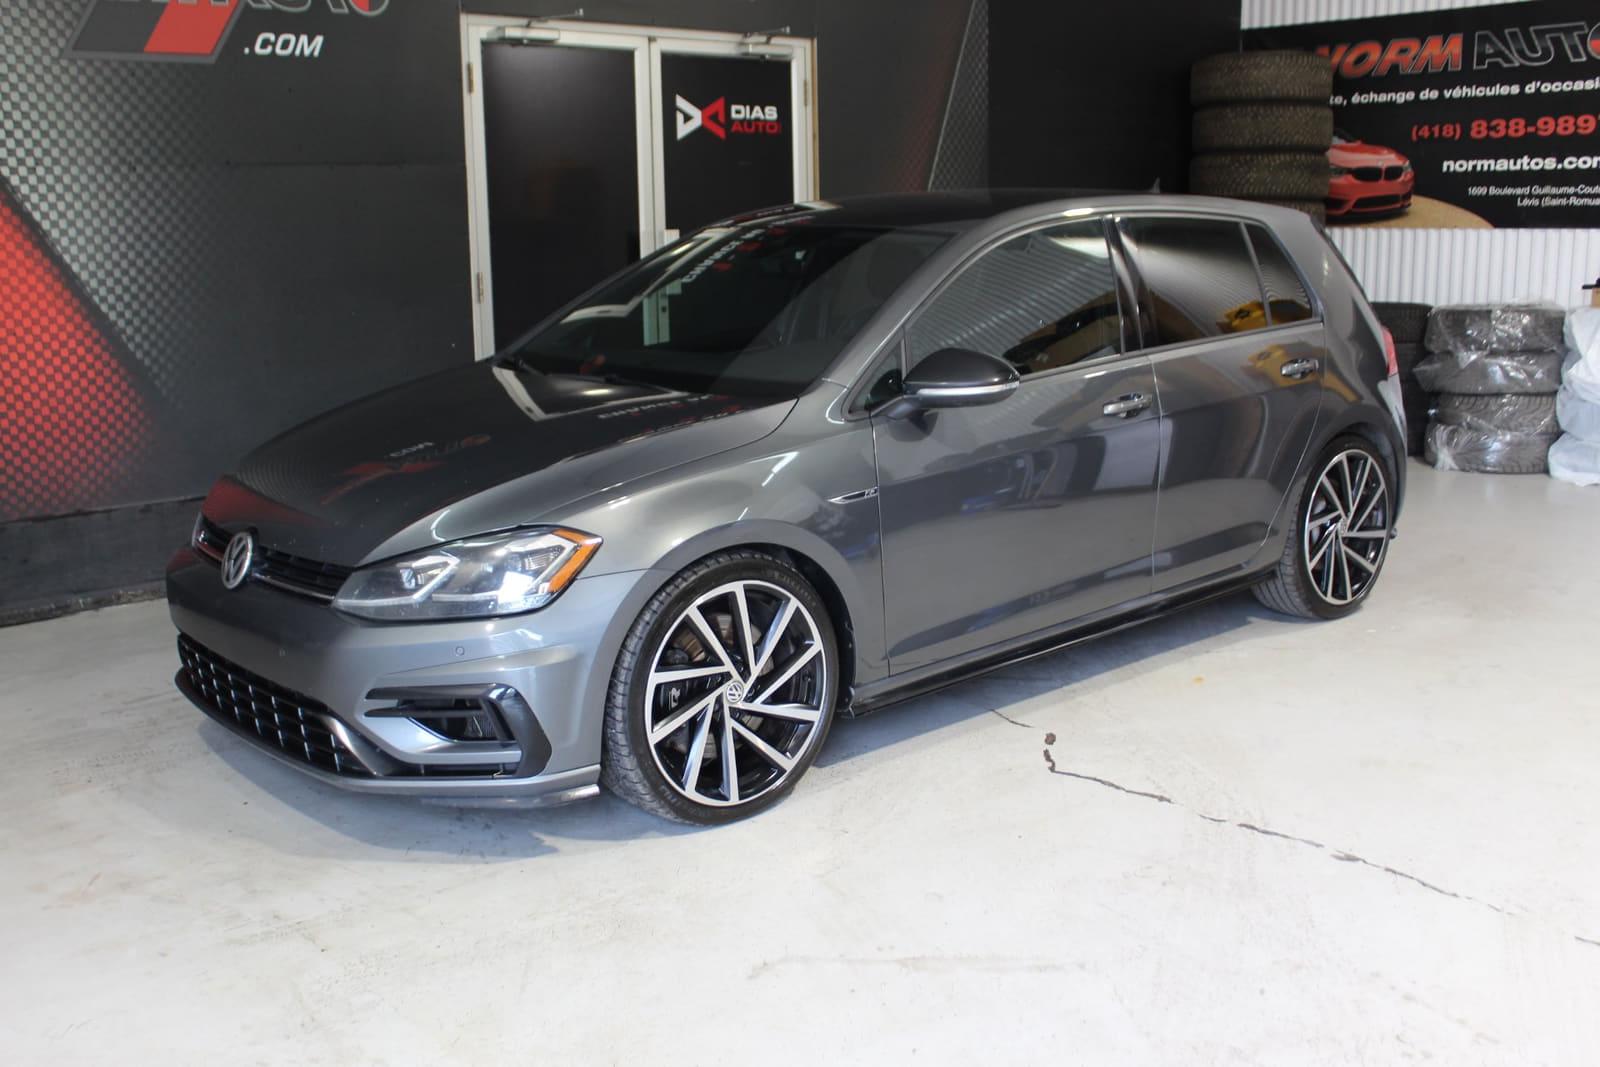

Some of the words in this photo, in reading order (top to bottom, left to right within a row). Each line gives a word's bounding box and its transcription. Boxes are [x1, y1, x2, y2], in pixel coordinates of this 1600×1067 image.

[243, 32, 324, 57] .COM
[1351, 91, 1415, 105] échange
[1419, 87, 1439, 101] de
[1443, 83, 1520, 99] véhicules
[731, 104, 778, 121] DIAS
[731, 121, 781, 134] AUTO
[1411, 123, 1461, 142] (418)
[1470, 114, 1600, 140] 838-989
[1489, 184, 1530, 196] Boulevard
